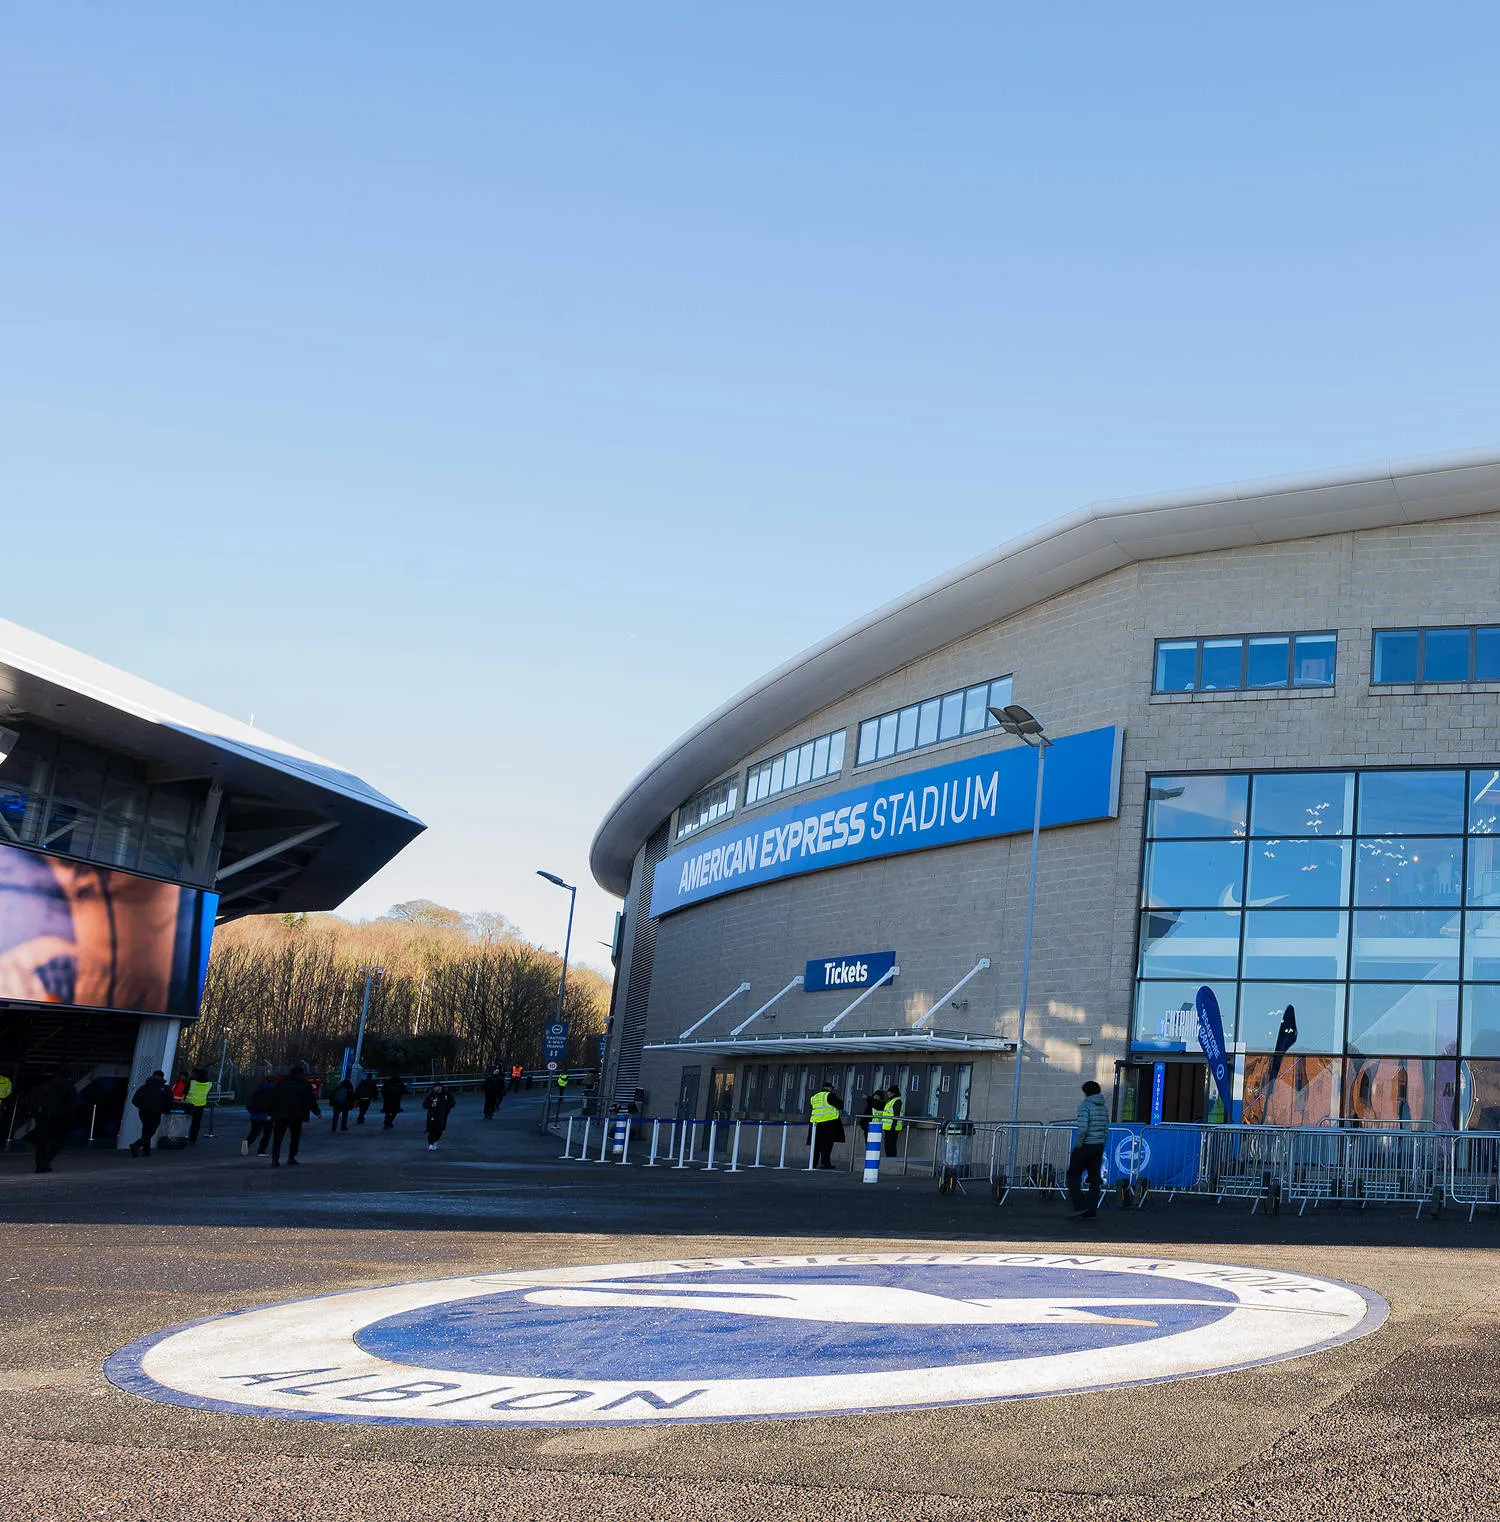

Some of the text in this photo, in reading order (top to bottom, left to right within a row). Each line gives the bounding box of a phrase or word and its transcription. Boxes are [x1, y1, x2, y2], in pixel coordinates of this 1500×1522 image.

[678, 770, 999, 896] AMERICAN EXPRESS STADIUM
[824, 960, 868, 985] Tickets
[671, 1254, 1326, 1295] BRIGHTON & HOVE
[219, 1366, 711, 1412] ALBION
